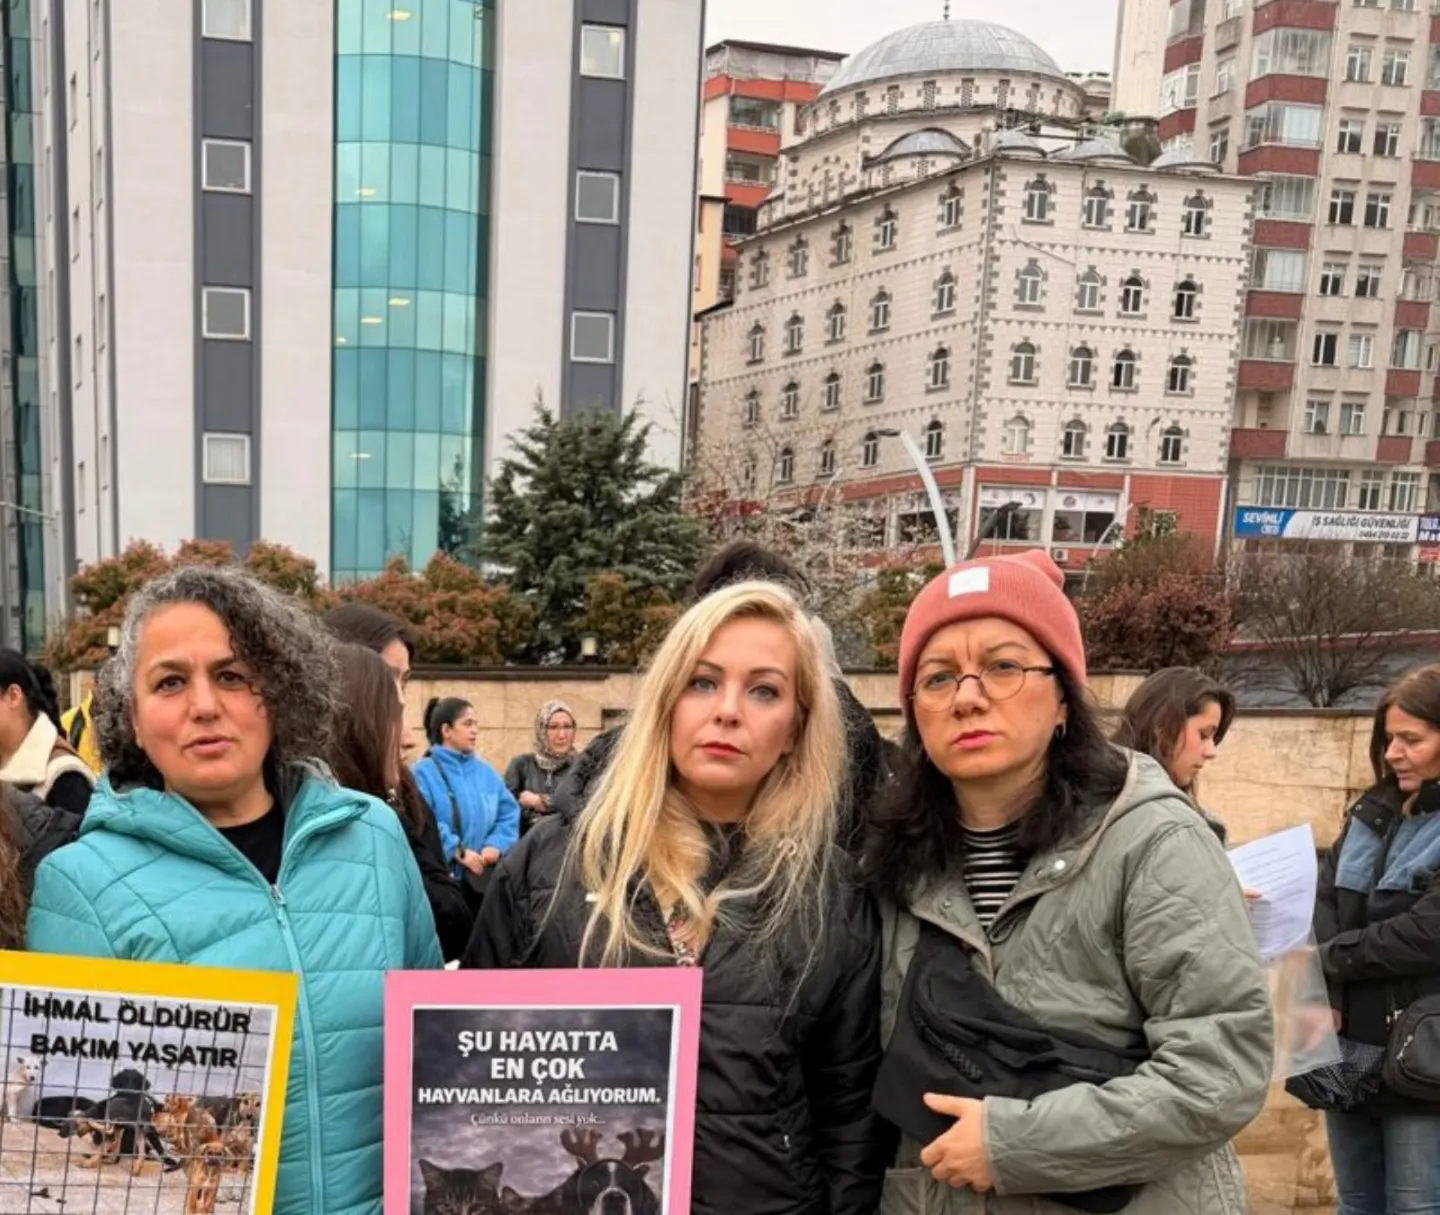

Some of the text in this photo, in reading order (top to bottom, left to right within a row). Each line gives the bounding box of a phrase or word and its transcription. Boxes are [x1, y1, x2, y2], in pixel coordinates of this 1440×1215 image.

[24, 992, 251, 1033] İHMAL ÖLDÜRÜR
[30, 1034, 239, 1068] BAKIM YAŞATIR
[457, 1030, 618, 1057] ŞU HAYATTA
[491, 1057, 586, 1085] EN ÇOK
[418, 1083, 661, 1105] HAYVANLARA AĞLIYORUM.
